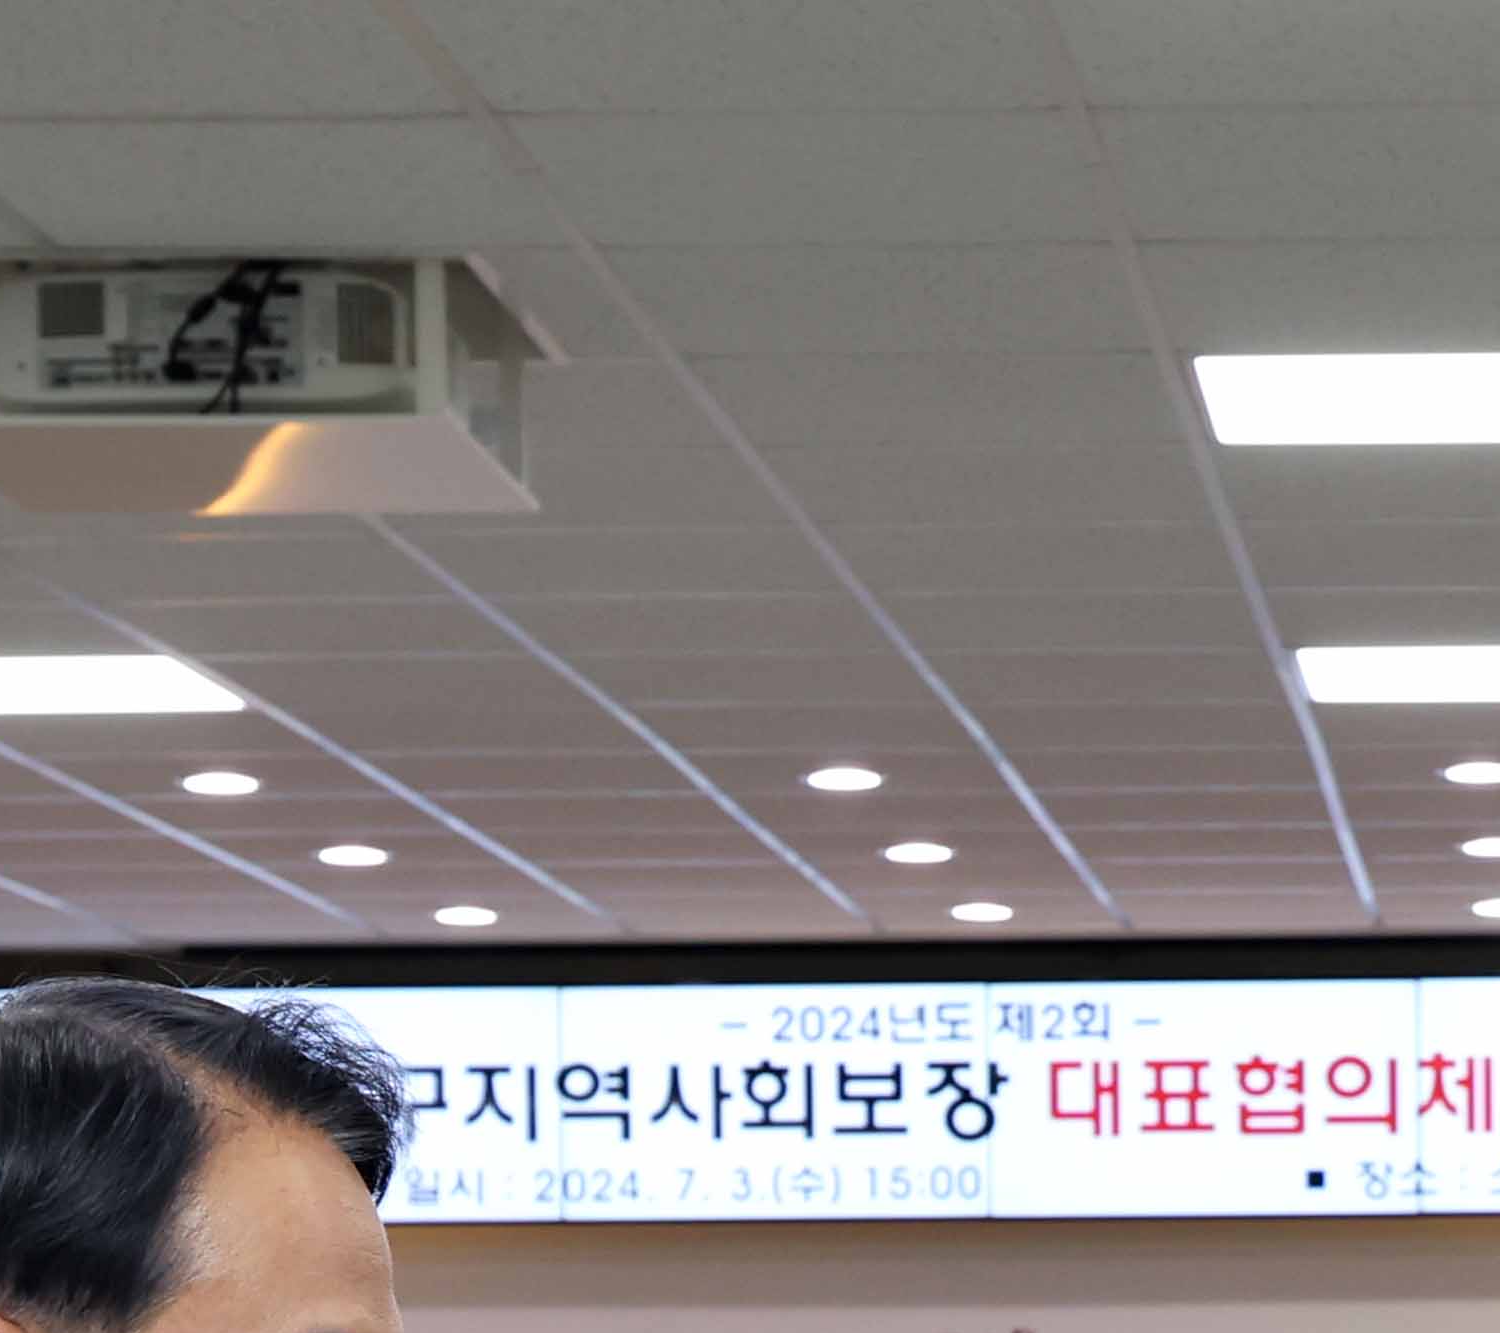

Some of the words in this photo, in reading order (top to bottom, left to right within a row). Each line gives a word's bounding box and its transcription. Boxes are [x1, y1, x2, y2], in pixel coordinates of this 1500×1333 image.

[772, 1006, 973, 1043] 2024년도
[996, 1003, 1110, 1040] 제2회
[1049, 1054, 1493, 1136] 대표협의체
[1358, 1160, 1438, 1201] 장소
